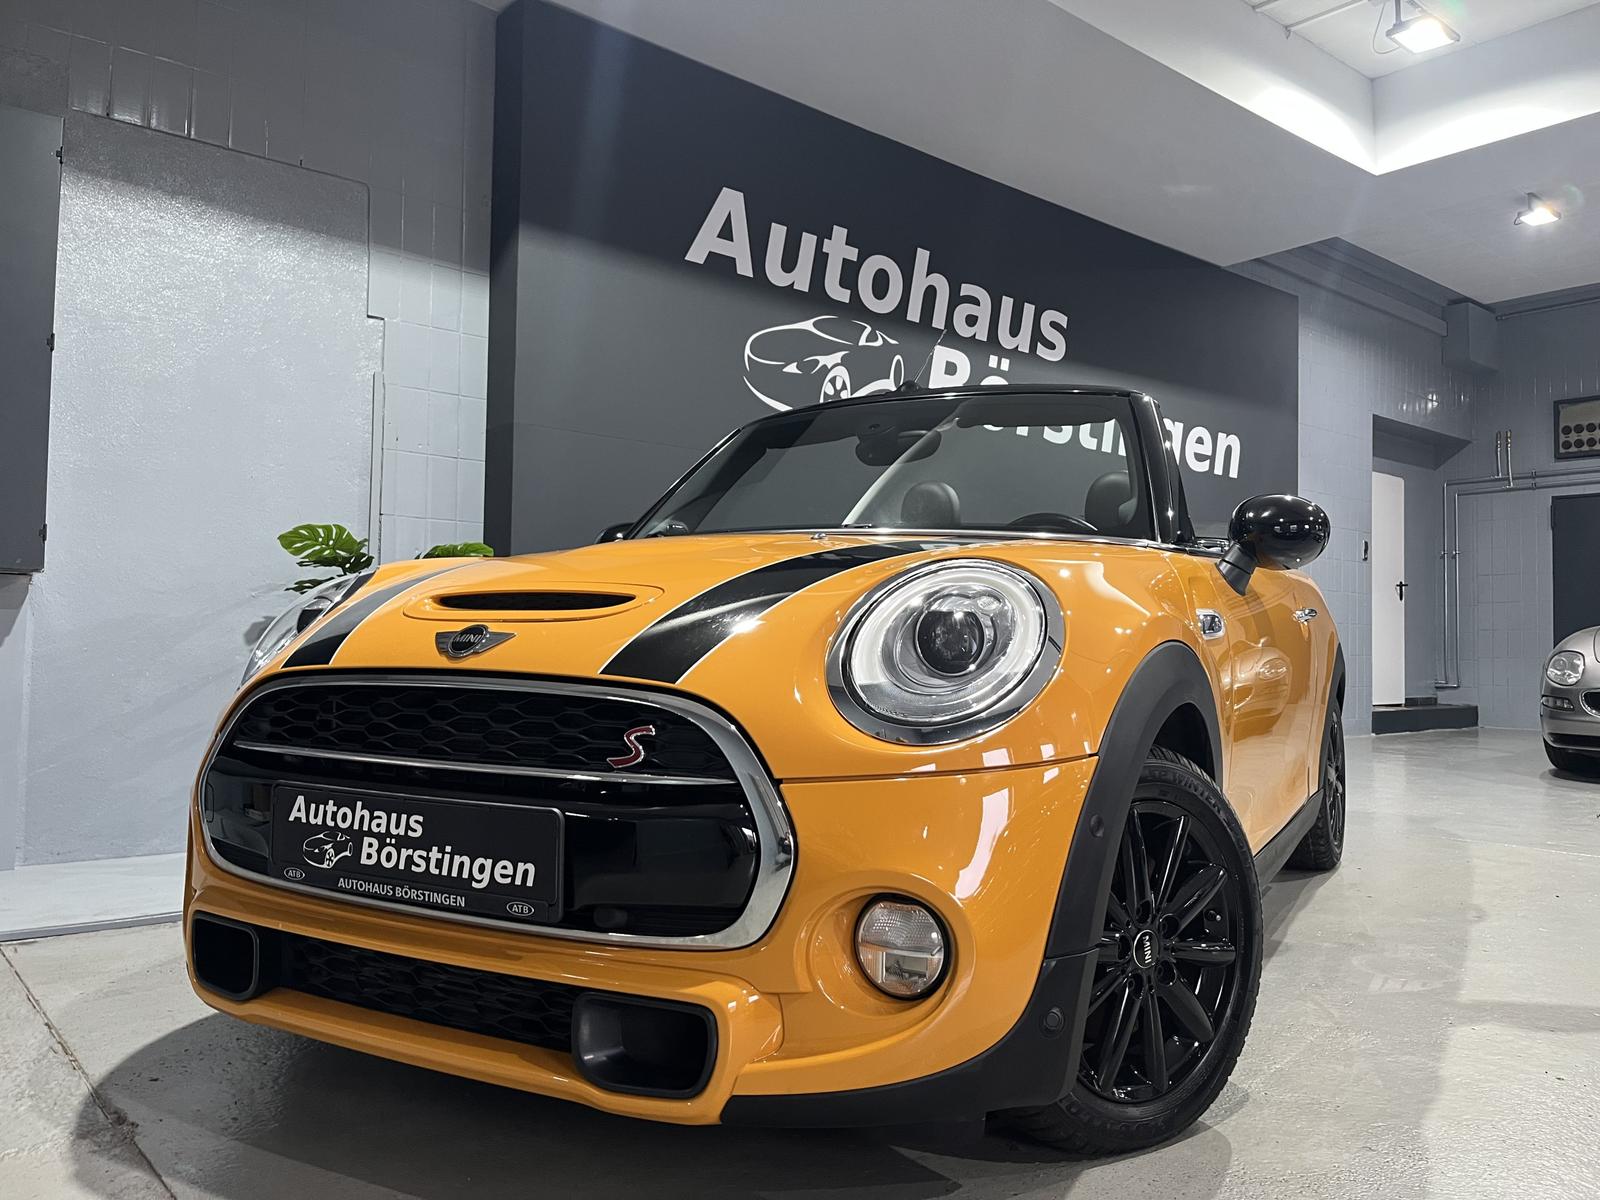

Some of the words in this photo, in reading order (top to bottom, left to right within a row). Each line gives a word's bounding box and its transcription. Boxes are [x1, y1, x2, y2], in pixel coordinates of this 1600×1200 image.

[685, 187, 1068, 362] Autohaus
[453, 633, 482, 643] MINI
[606, 724, 656, 768] S
[288, 795, 424, 838] Autohaus
[359, 837, 536, 888] Börstingen
[337, 877, 393, 896] AUTOHAUS
[395, 885, 465, 907] BÖRSTINGEN
[511, 904, 529, 915] ATB
[1142, 935, 1152, 964] MINI
